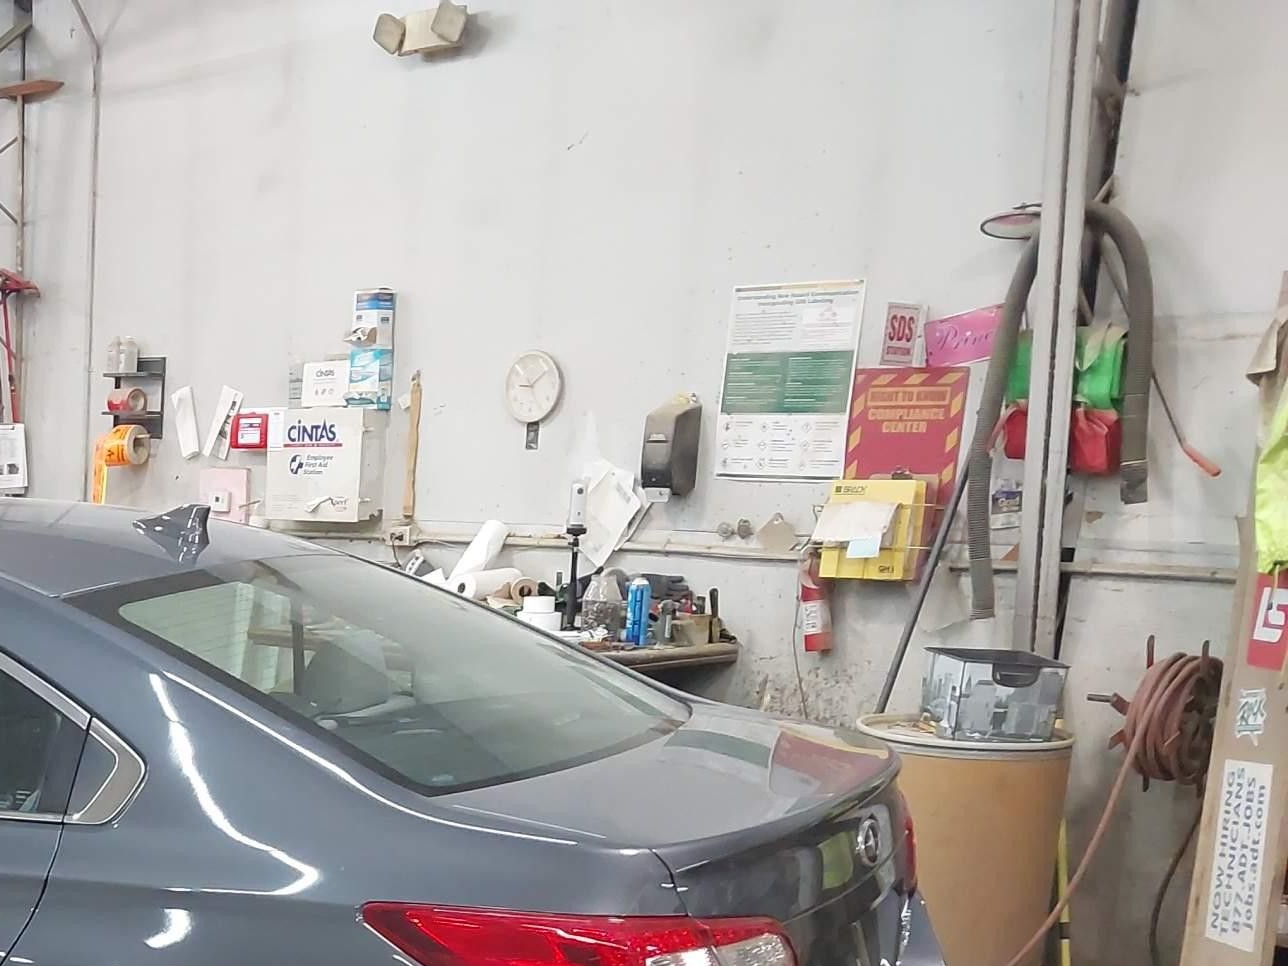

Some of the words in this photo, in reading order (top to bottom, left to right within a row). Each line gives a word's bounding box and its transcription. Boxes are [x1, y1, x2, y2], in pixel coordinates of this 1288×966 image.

[887, 314, 915, 342] SDS
[868, 408, 946, 420] COMPLIANCE
[881, 421, 928, 433] CENTER
[1210, 866, 1224, 929] NOW
[1218, 770, 1236, 858] HIRING
[1219, 766, 1246, 936] TECHNICIANS
